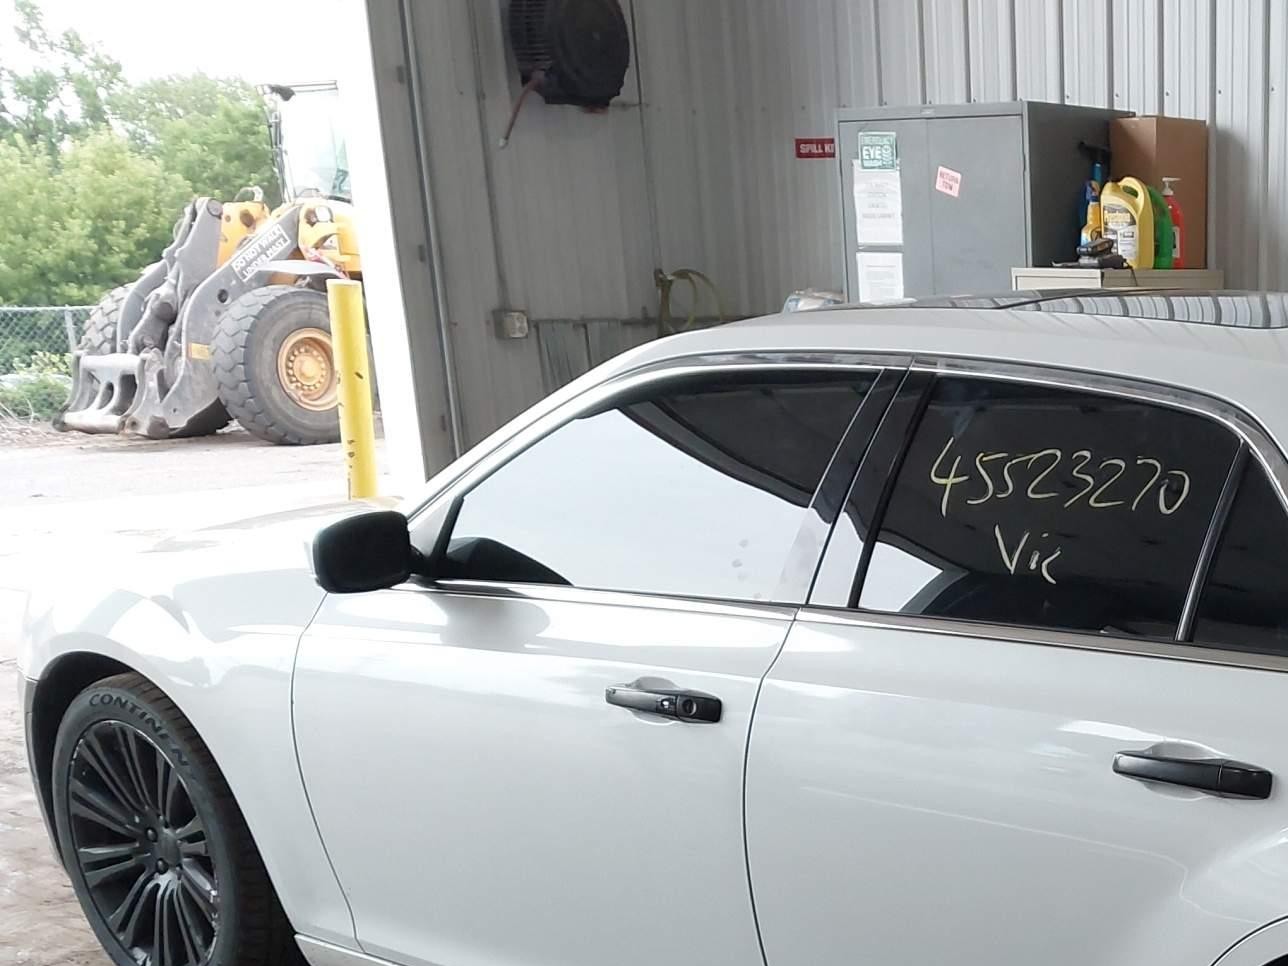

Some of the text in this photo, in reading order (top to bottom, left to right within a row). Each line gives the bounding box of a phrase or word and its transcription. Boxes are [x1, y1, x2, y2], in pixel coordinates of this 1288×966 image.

[800, 143, 823, 153] SPILL
[863, 146, 881, 159] EYE
[233, 227, 283, 271] DO NOT WALK
[930, 436, 1190, 517] 45523270
